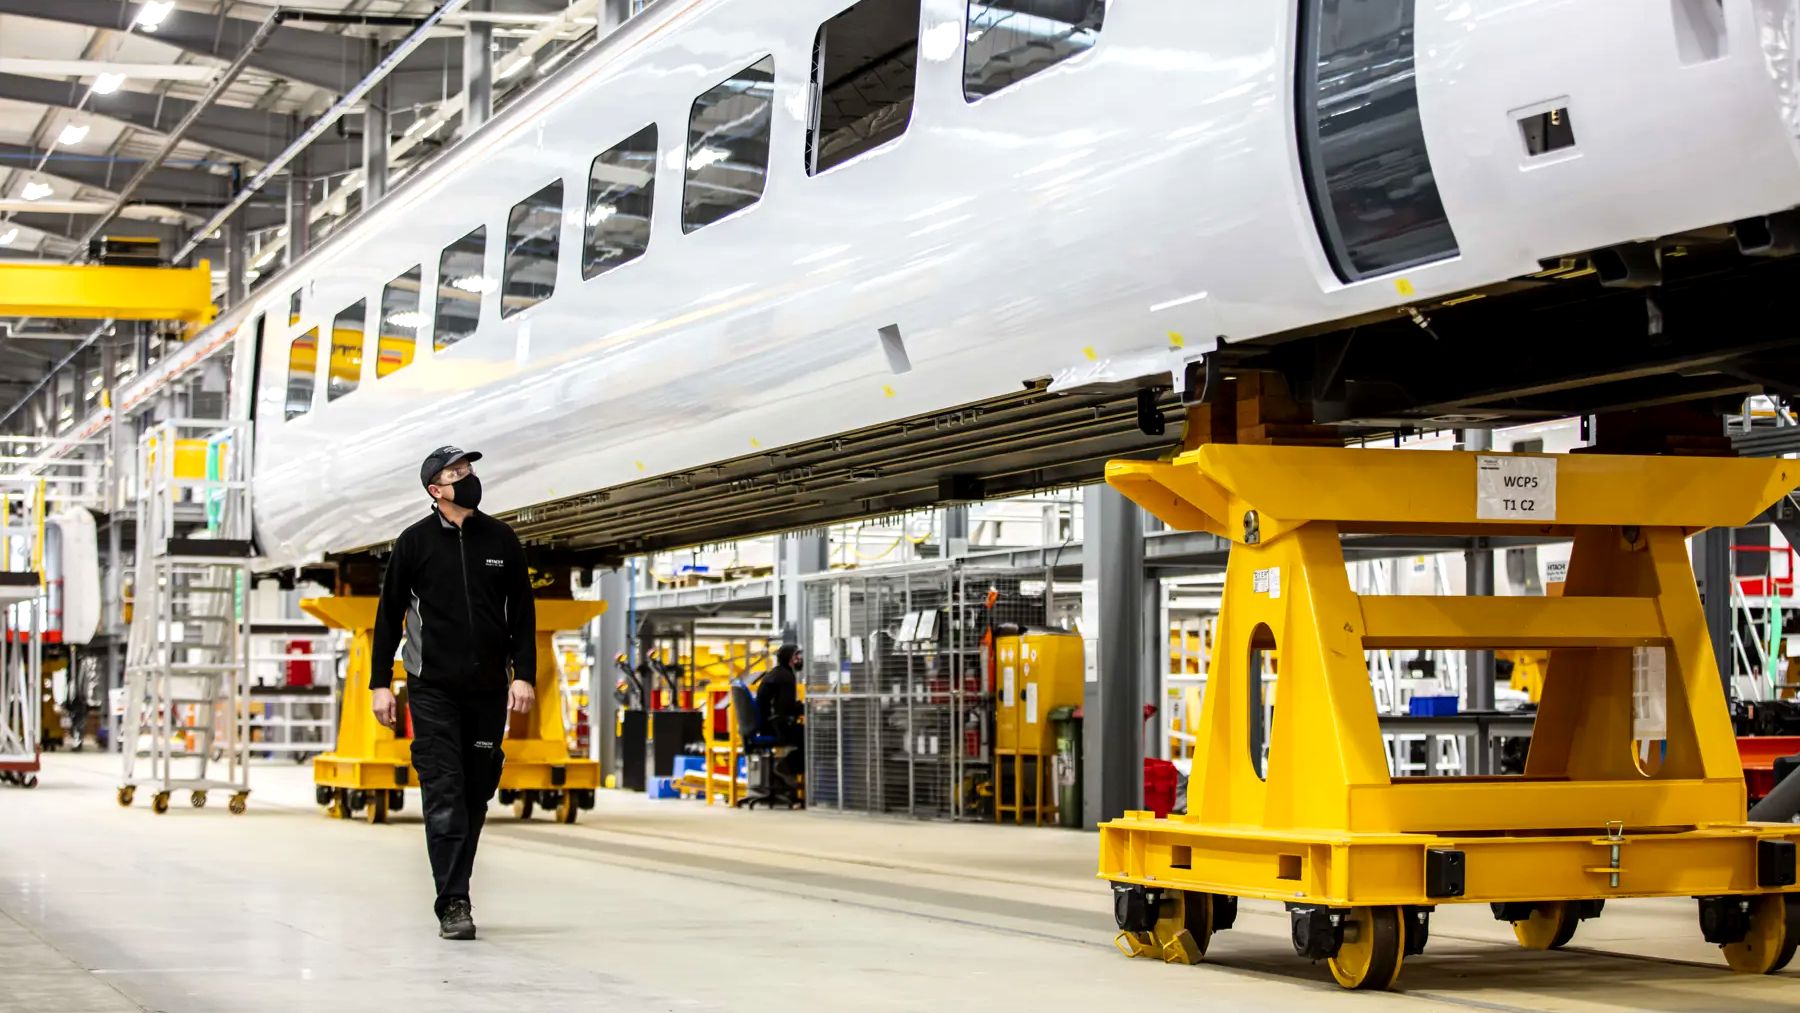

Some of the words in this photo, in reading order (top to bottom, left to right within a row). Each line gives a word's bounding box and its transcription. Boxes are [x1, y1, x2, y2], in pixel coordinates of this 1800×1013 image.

[1504, 476, 1538, 488] WCP5
[1503, 499, 1517, 511] T1
[1520, 499, 1535, 511] C2
